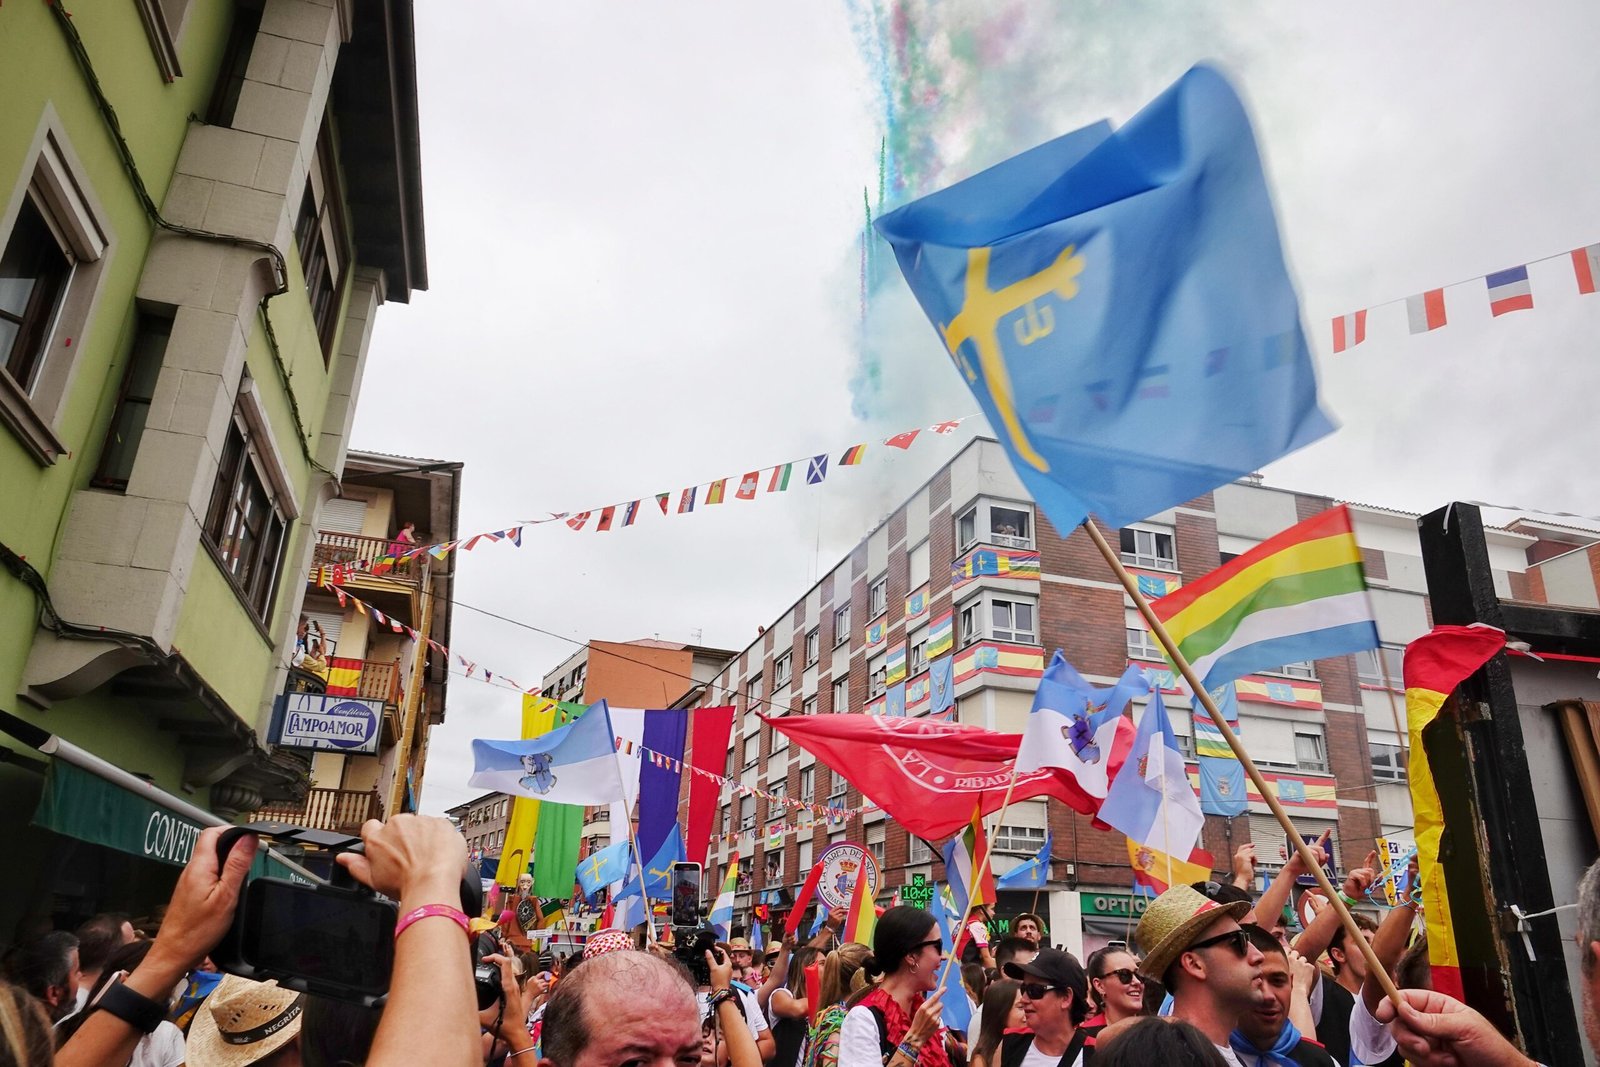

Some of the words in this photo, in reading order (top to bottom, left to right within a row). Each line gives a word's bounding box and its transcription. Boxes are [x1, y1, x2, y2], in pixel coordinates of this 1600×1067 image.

[288, 713, 364, 738] CAMPOAMOR
[144, 810, 204, 864] CONFIT
[1094, 896, 1147, 913] OPTIC
[264, 1006, 301, 1035] NEGRITA
